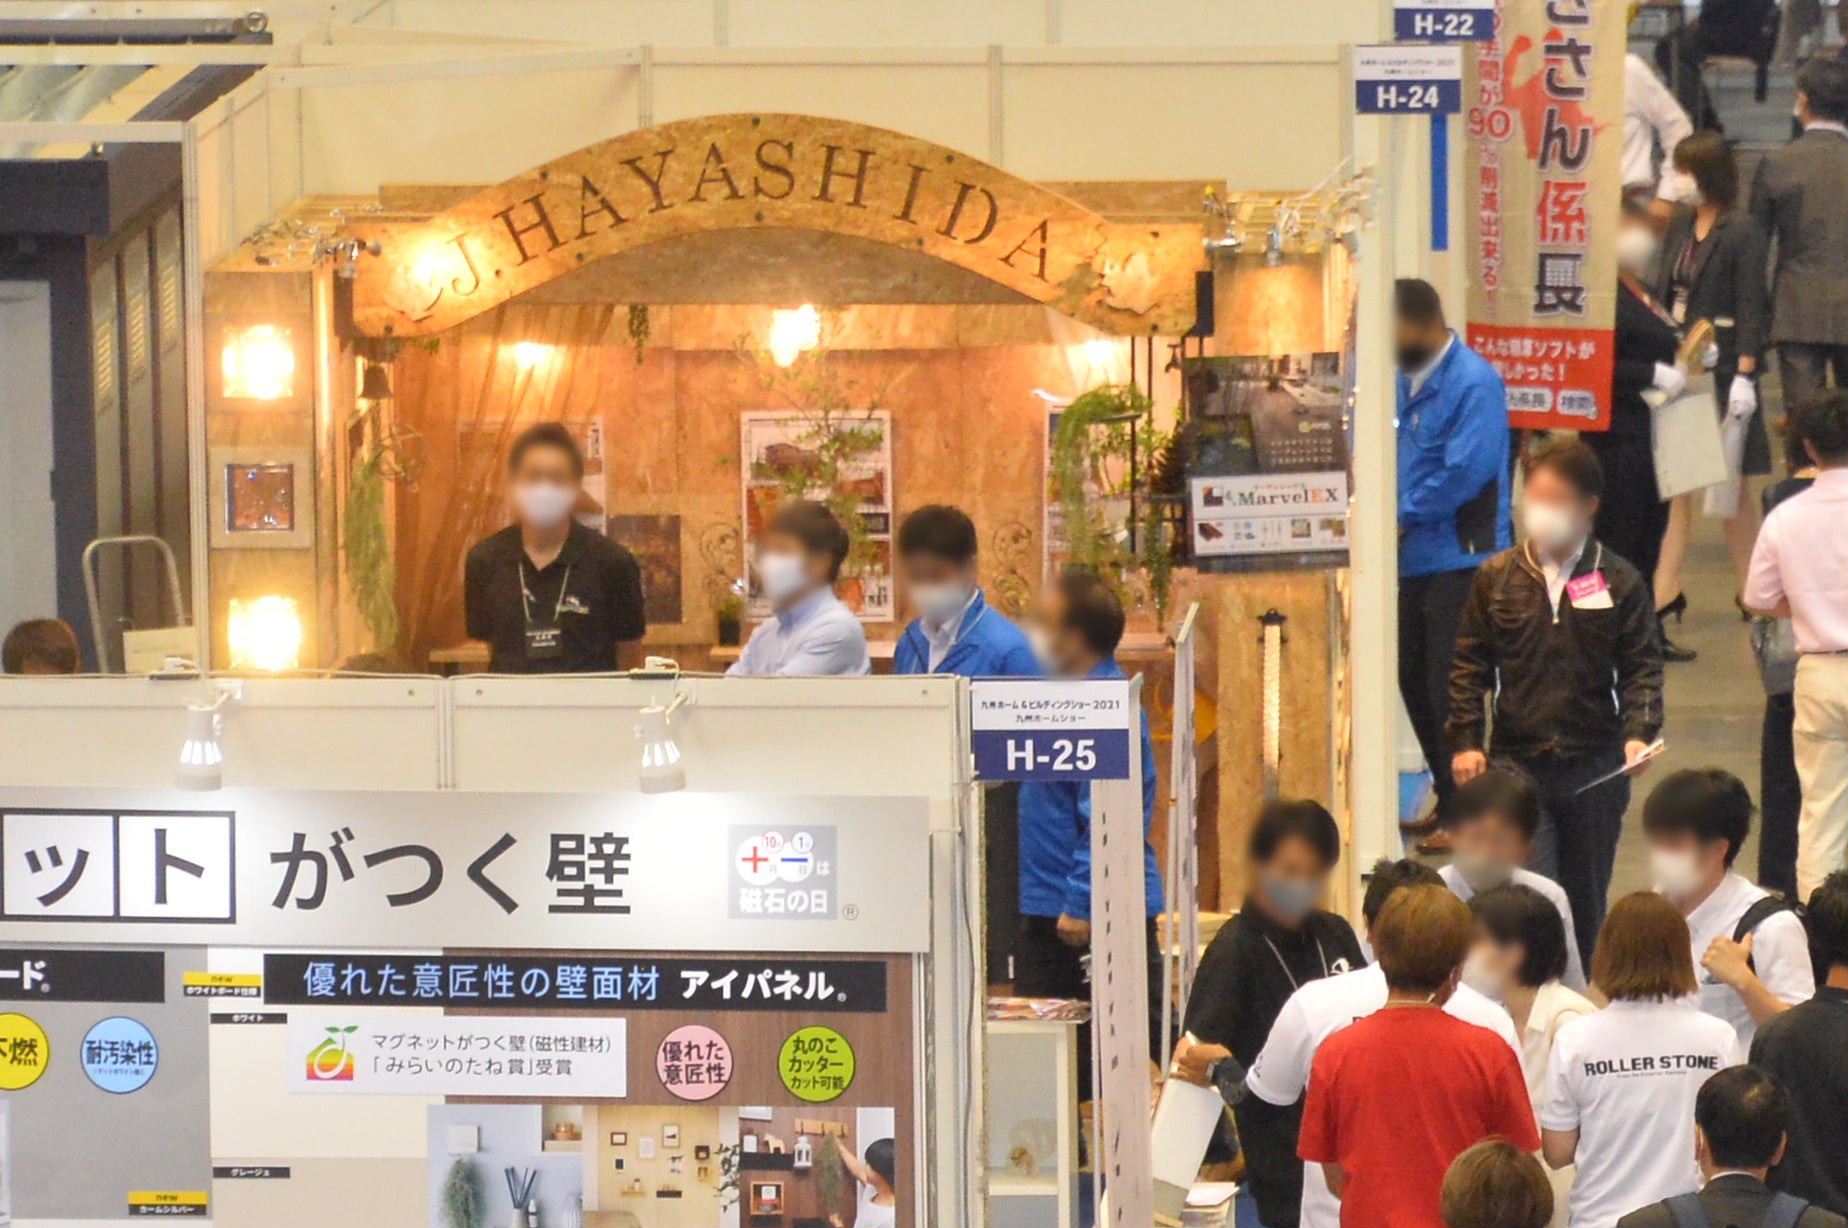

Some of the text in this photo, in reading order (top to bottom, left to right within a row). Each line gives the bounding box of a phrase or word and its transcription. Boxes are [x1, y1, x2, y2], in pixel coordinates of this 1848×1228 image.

[1414, 13, 1475, 36] H-22
[1376, 86, 1439, 109] H-24
[1006, 739, 1097, 771] H-25
[739, 887, 828, 914] 磁石の日
[303, 961, 835, 1002] 優れた意匠性の壁面材 アイパネル
[231, 1013, 264, 1023] ホワイト
[86, 1040, 154, 1066] 耐汚染性
[372, 1033, 612, 1054] マグネットがつく壁(磁性建材)
[662, 1039, 725, 1062] 優れた
[793, 1036, 837, 1055] 丸のこ
[663, 1062, 726, 1086] 意匠性
[788, 1056, 844, 1074] カッター
[1584, 1055, 1718, 1077] ROLLER STONE
[790, 1075, 845, 1091] カット可能
